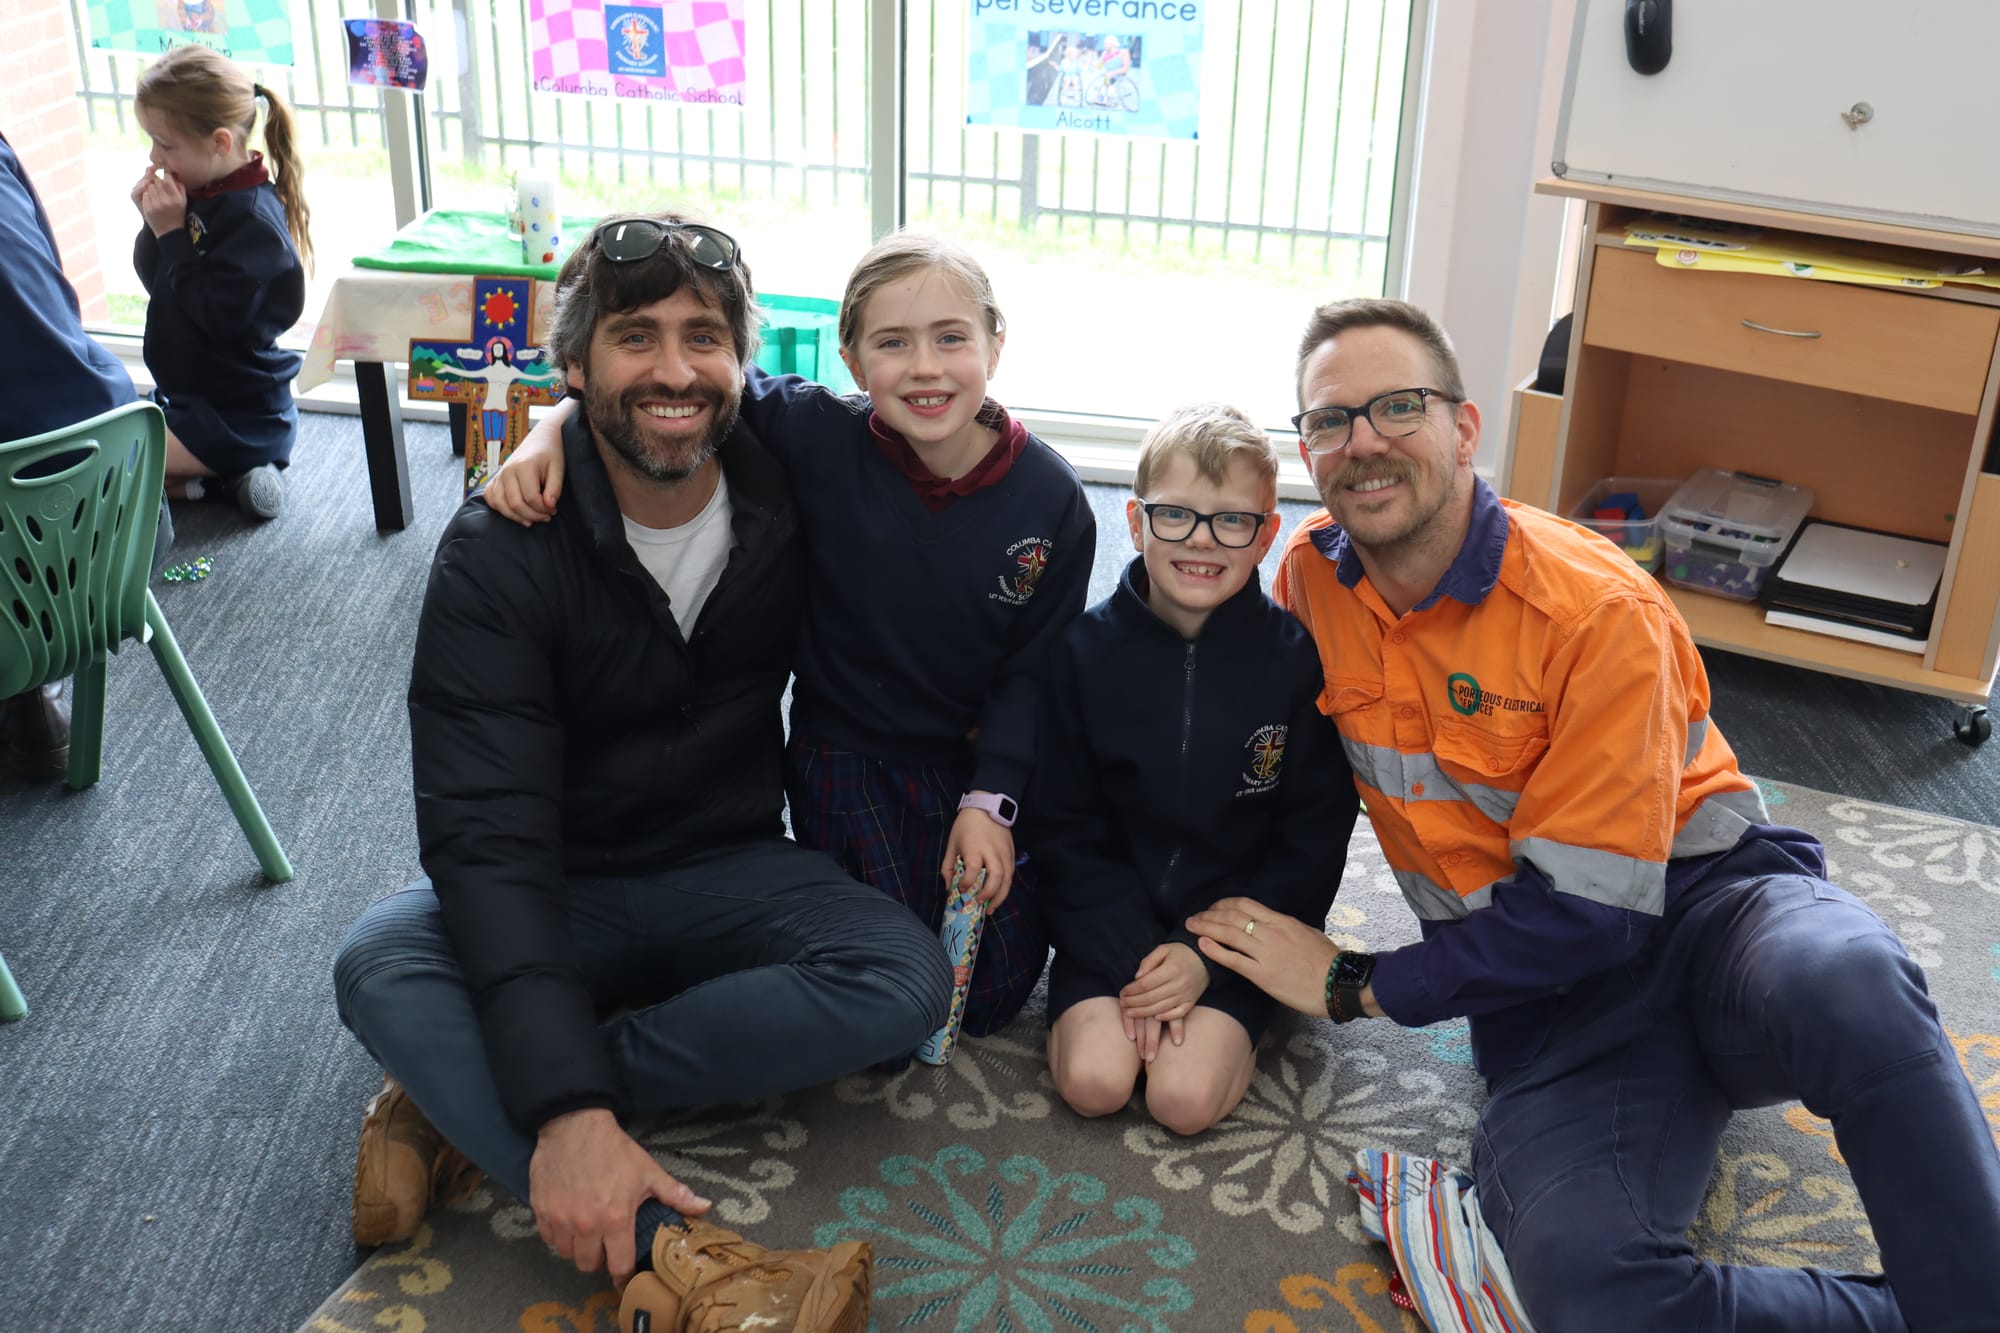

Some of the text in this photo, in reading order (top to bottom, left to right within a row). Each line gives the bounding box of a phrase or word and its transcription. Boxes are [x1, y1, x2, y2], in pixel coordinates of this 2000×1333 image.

[539, 75, 742, 105] Columba Catholic School
[1055, 110, 1112, 130] Alcott
[1006, 537, 1041, 556] COLUMBA
[1459, 685, 1545, 713] PORTEOUS ELTRICAL
